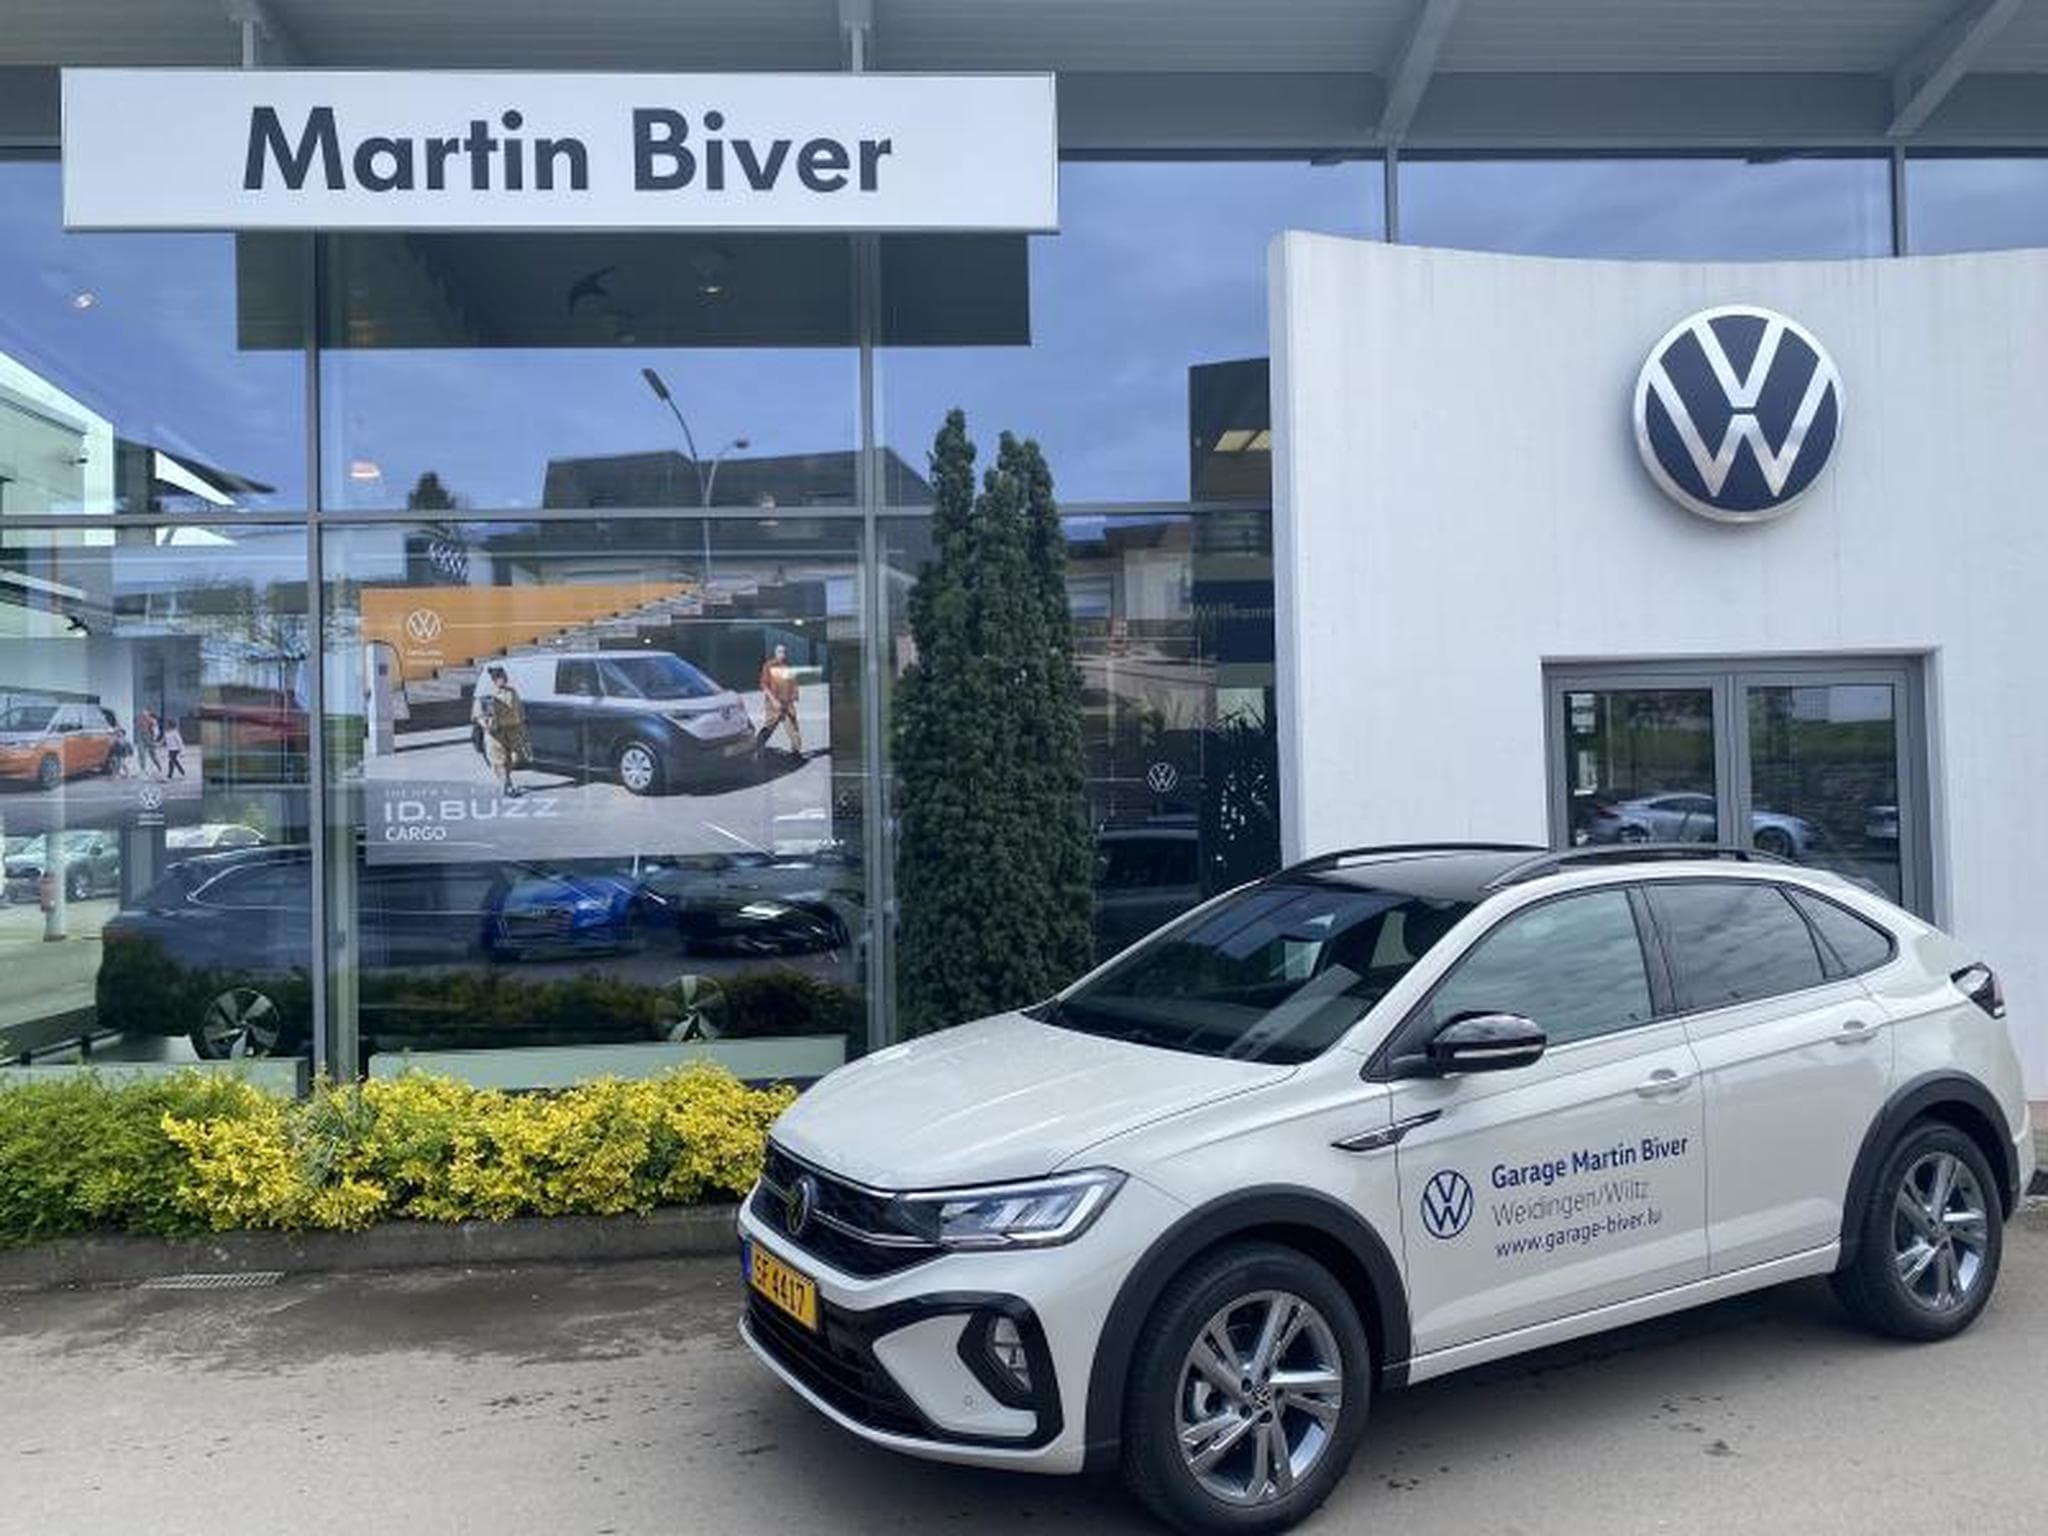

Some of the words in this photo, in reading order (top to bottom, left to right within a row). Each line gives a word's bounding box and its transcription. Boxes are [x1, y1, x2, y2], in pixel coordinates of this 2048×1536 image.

[243, 105, 588, 192] Martin
[631, 107, 892, 193] Biver
[385, 800, 433, 821] ID.
[439, 798, 558, 820] BUZZ
[385, 827, 447, 841] CARGO
[1491, 1160, 1566, 1189] Garage
[1572, 1143, 1636, 1174] Martin
[1641, 1137, 1688, 1161] Biver
[1491, 1180, 1650, 1227] Weidingen/Wiltz
[1495, 1207, 1662, 1258] www.garage-biver.lu
